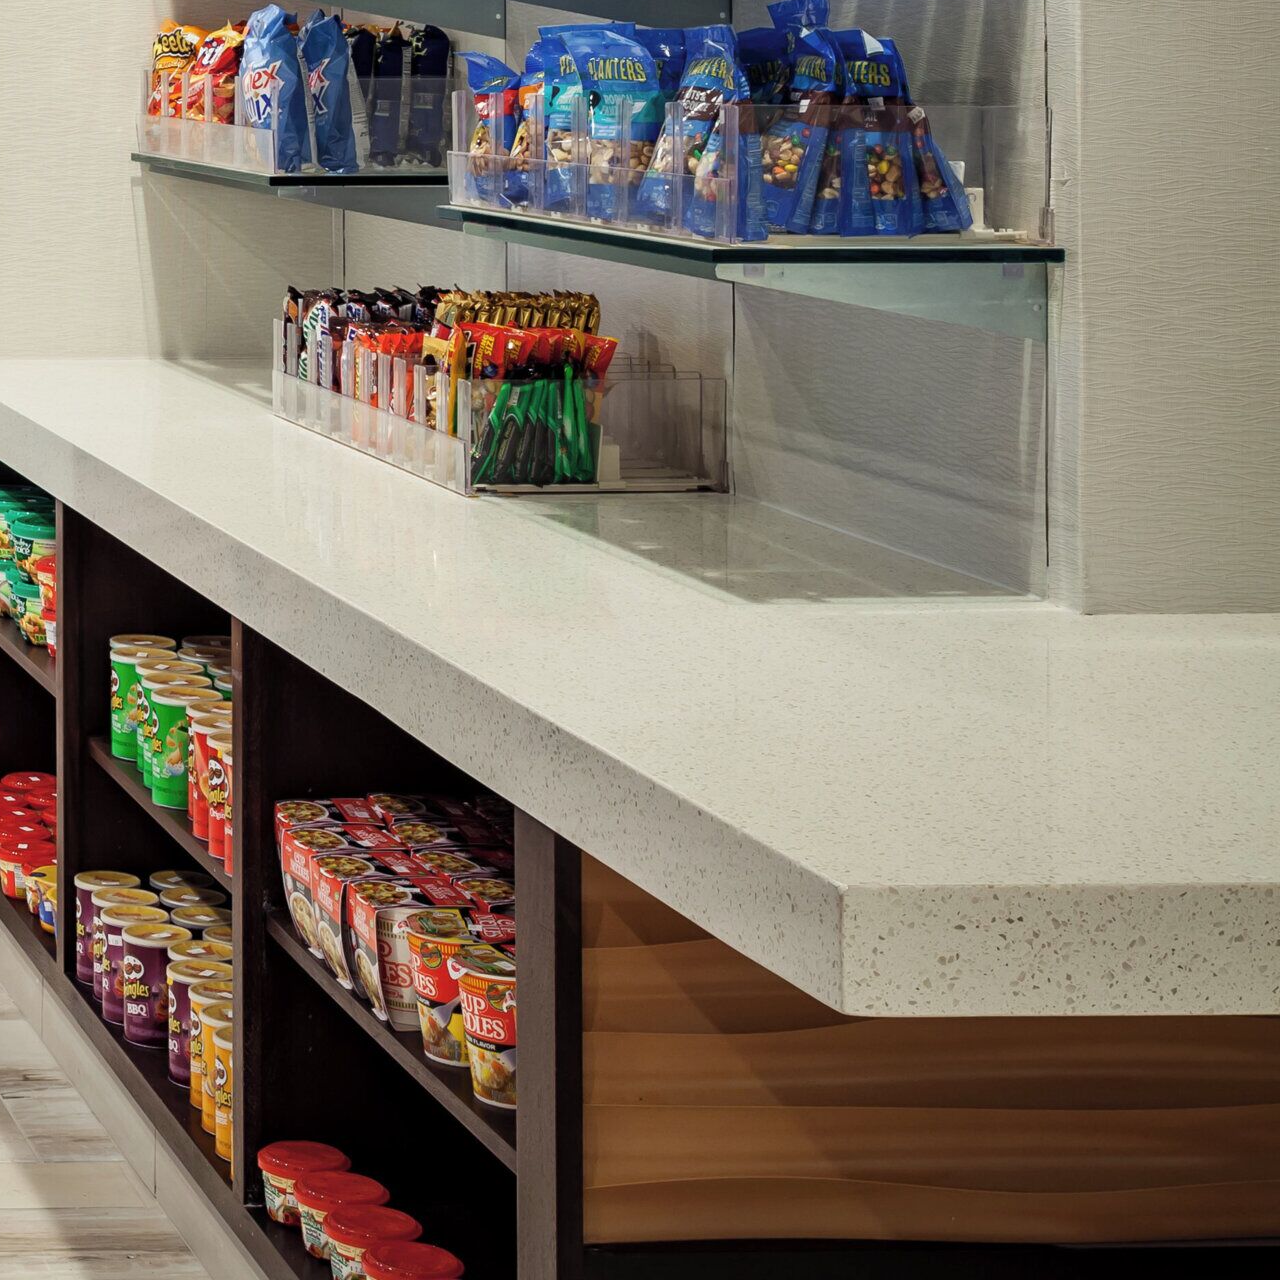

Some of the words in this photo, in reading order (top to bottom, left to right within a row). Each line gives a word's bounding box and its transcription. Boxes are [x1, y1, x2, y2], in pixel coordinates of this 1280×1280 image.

[588, 56, 646, 81] PLANTERS
[603, 94, 633, 105] ROPICAL
[474, 334, 489, 369] SHARING
[485, 335, 495, 356] SIZE
[510, 339, 521, 360] SIZE
[124, 980, 150, 999] ingles
[127, 1001, 148, 1017] BBQ
[462, 1012, 508, 1041] DLES
[473, 1037, 496, 1050] FLAVOR
